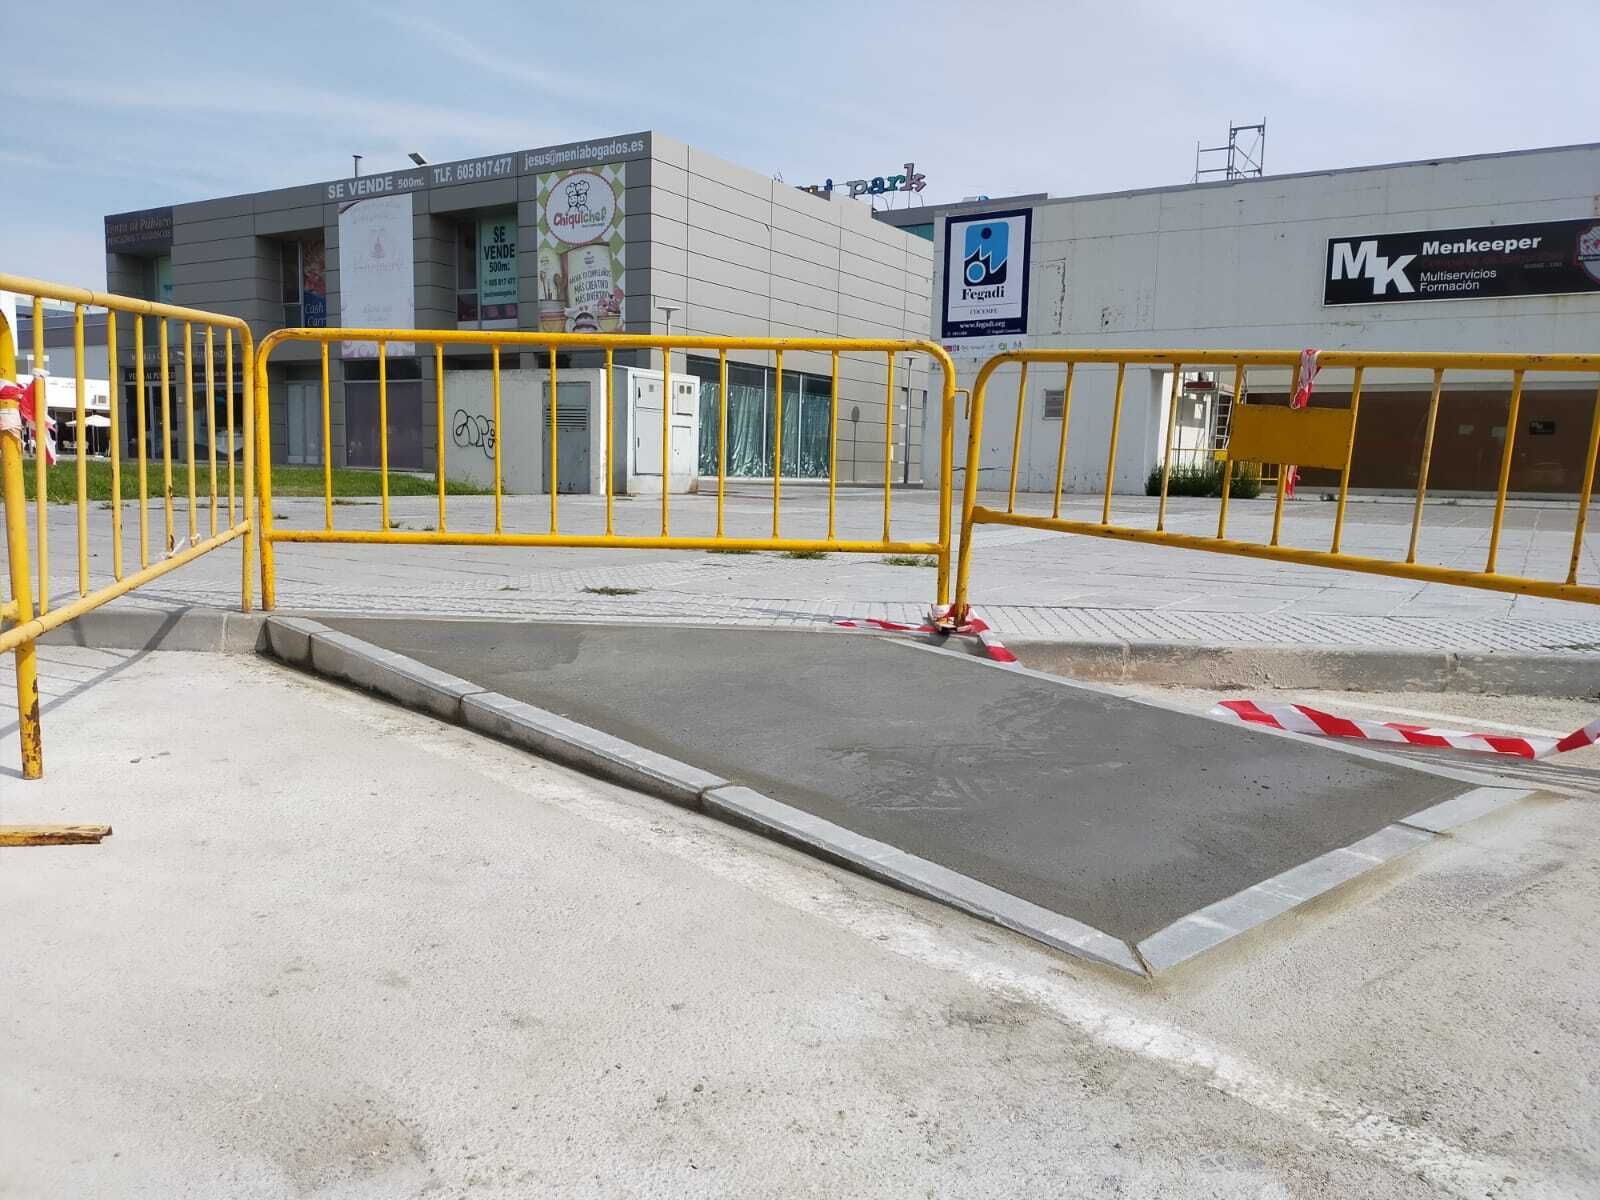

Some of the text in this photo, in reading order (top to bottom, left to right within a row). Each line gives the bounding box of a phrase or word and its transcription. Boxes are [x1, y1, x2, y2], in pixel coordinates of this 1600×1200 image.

[433, 166, 453, 184] TLF.
[846, 162, 927, 200] park
[328, 183, 344, 199] SE
[348, 176, 393, 196] VENDE
[493, 225, 506, 243] SE
[483, 243, 516, 260] VENDE
[1422, 236, 1542, 256] Menkeeper
[1331, 240, 1417, 295] MK
[1419, 269, 1497, 282] Multiservicios
[962, 286, 1005, 301] Fegadi
[1419, 280, 1480, 293] Formación
